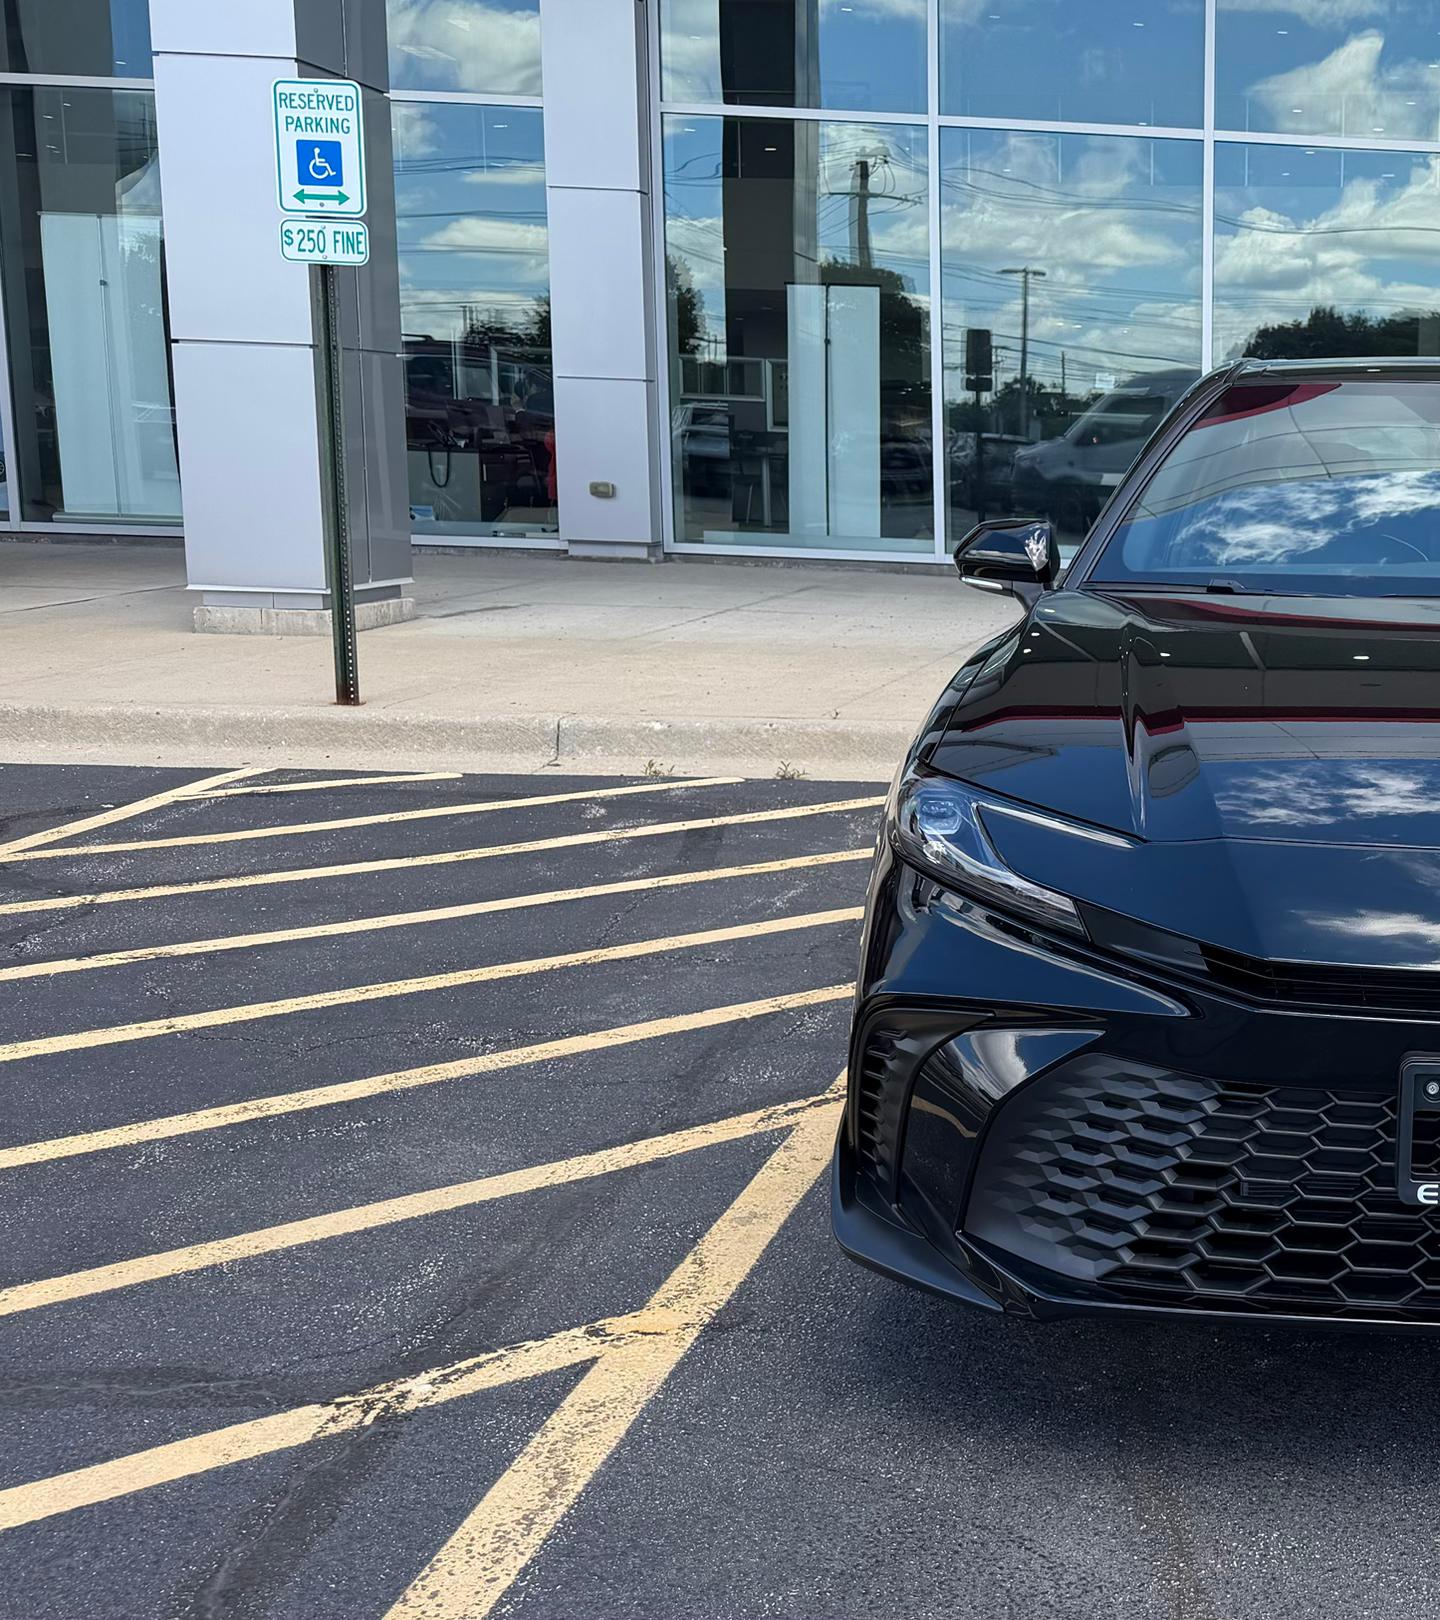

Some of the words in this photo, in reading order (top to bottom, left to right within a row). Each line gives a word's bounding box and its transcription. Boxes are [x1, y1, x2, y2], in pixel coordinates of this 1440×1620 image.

[279, 92, 354, 112] RESERVED
[285, 116, 351, 134] PARKING
[284, 228, 326, 253] $250
[333, 230, 365, 255] FINE
